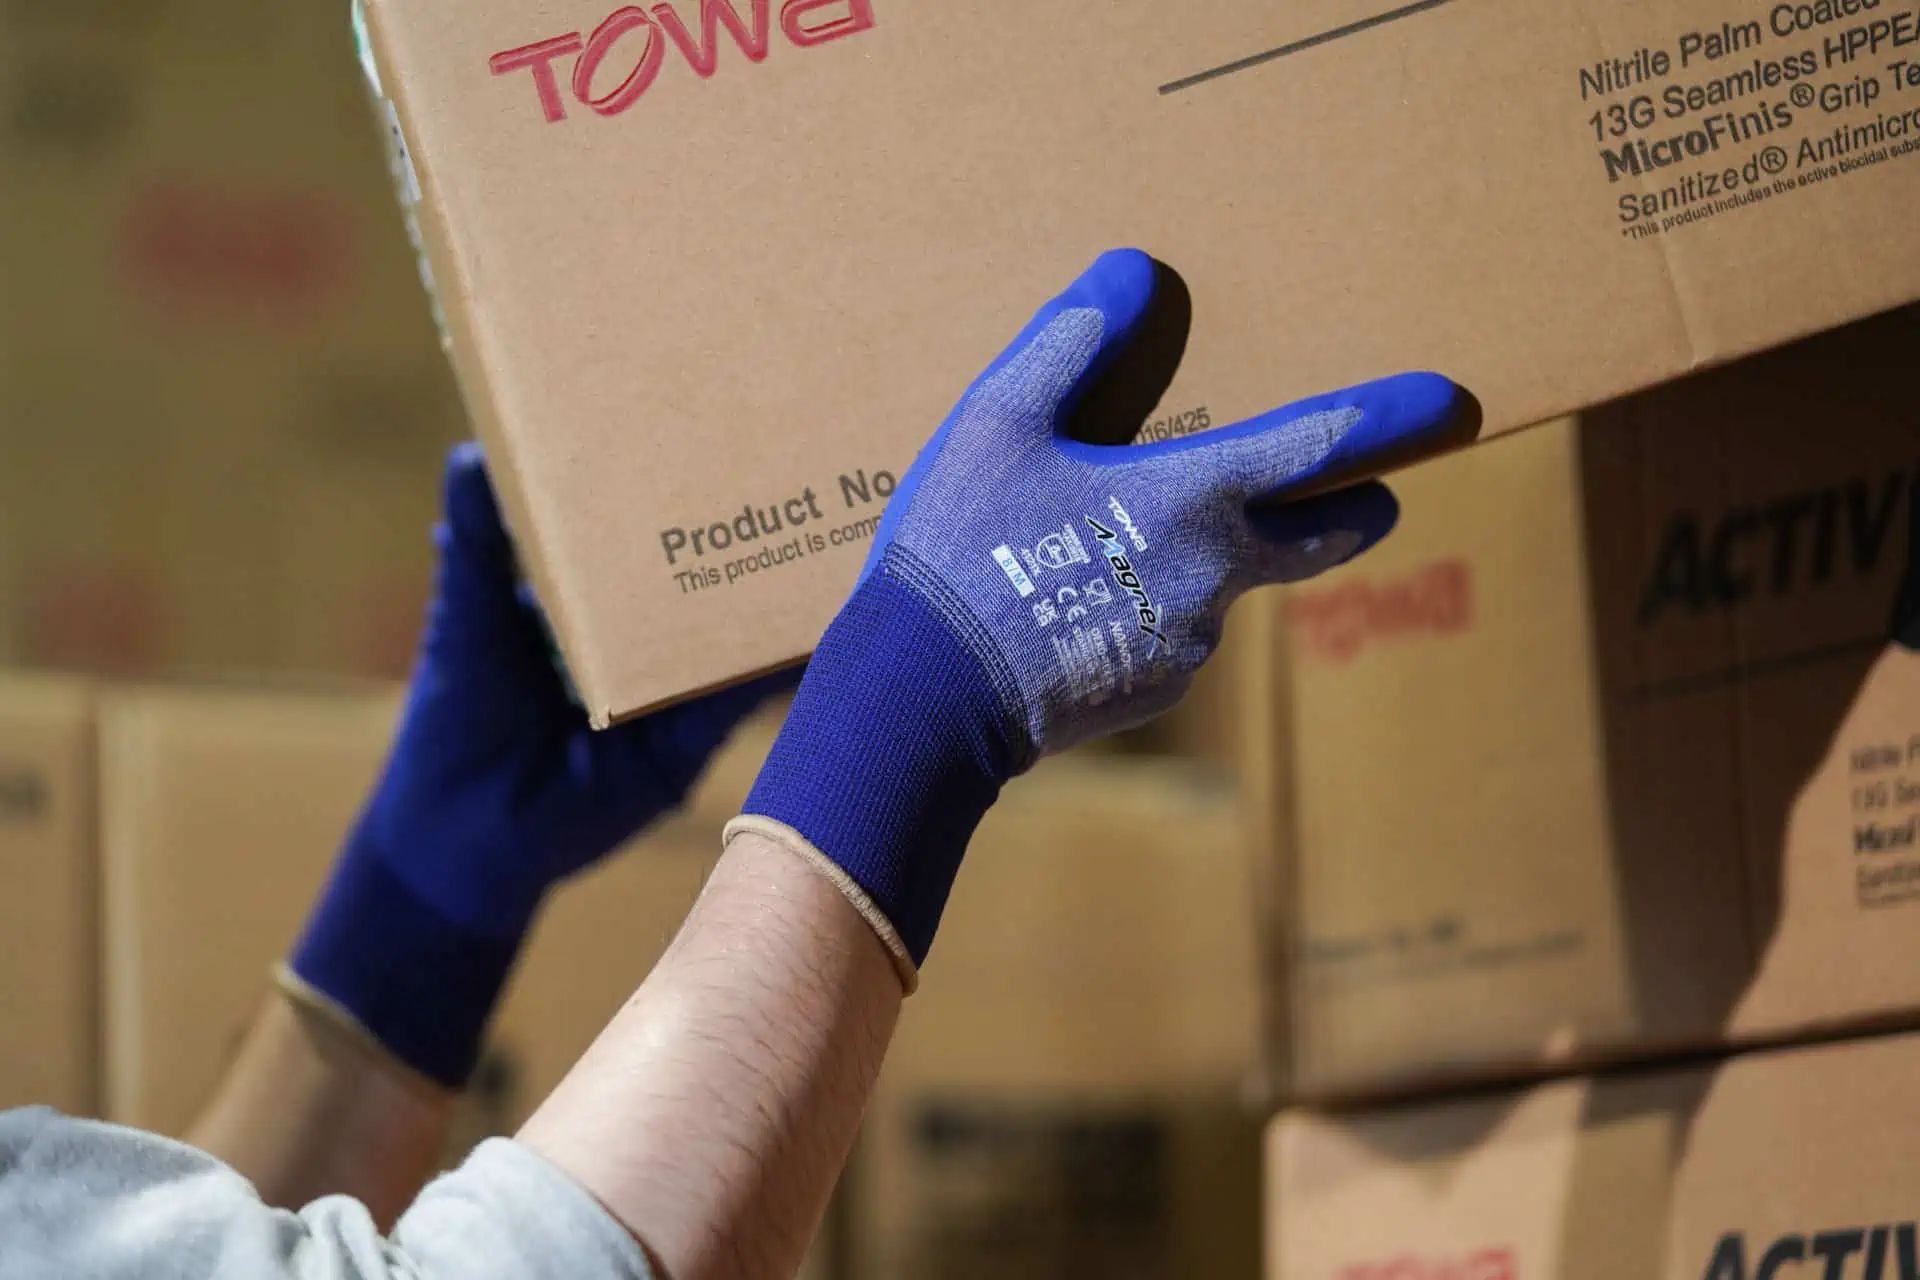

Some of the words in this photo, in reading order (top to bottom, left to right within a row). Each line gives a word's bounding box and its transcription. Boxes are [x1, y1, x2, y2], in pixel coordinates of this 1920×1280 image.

[1579, 48, 1670, 100] Nitrile
[1679, 21, 1761, 68] Palm
[1589, 95, 1656, 141] 13G
[1663, 50, 1818, 118] Seamless
[1662, 203, 1714, 232] product
[1715, 186, 1772, 213] includes
[1774, 177, 1797, 195] the
[1798, 163, 1838, 187] active
[1839, 147, 1890, 173] biocidal
[661, 485, 823, 565] Product
[673, 567, 721, 594] This
[724, 538, 804, 584] product
[805, 532, 826, 554] is
